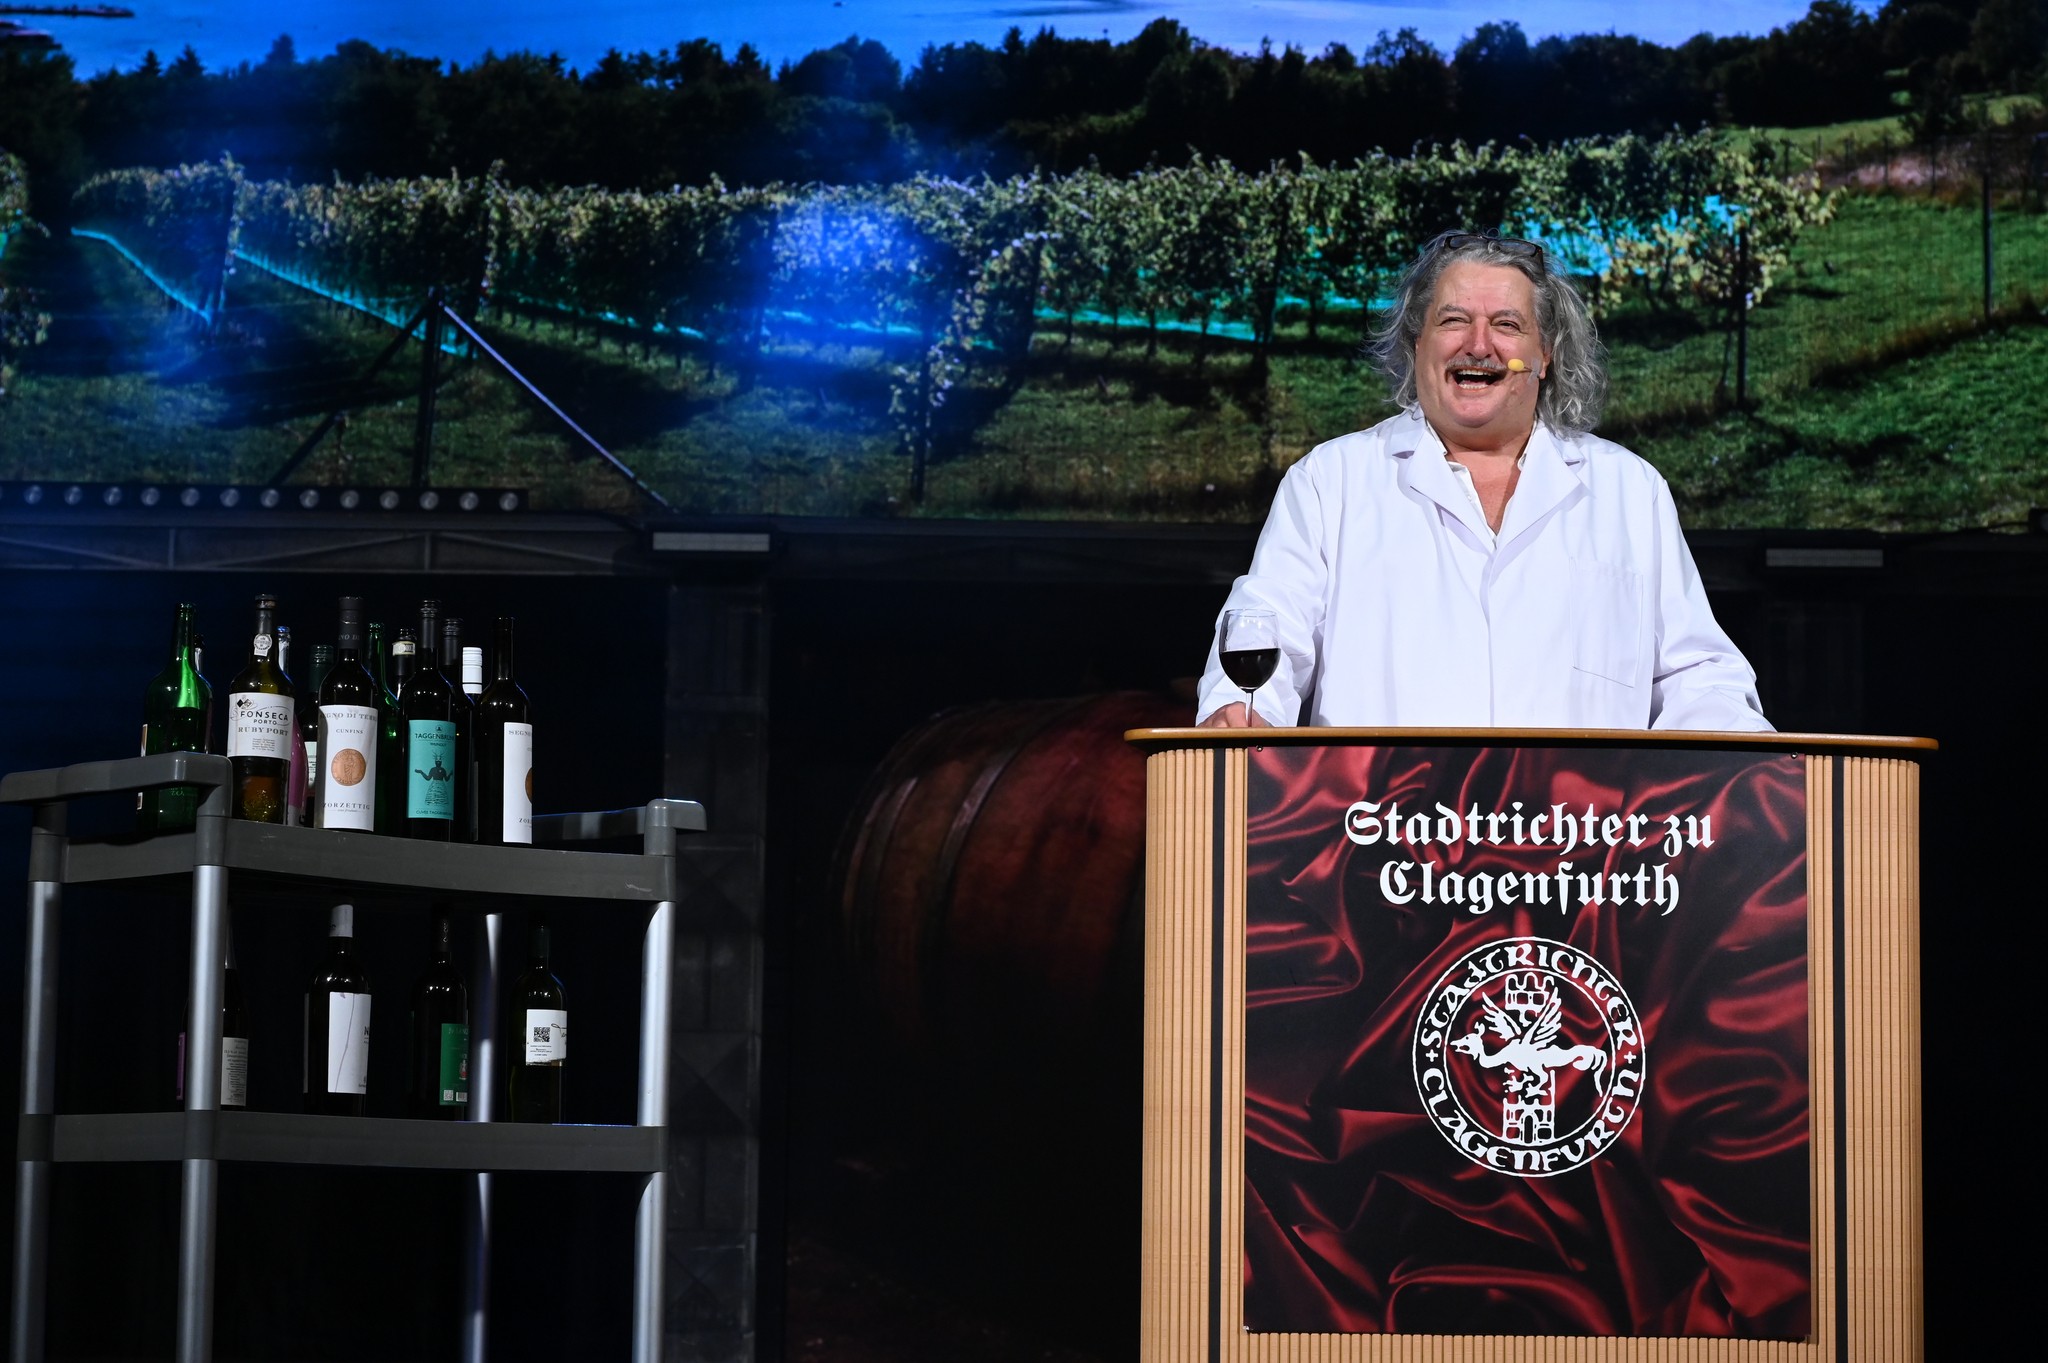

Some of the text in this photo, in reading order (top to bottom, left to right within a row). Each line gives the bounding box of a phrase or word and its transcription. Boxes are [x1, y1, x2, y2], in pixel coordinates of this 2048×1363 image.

[240, 710, 289, 722] FONSECA
[253, 718, 278, 726] PORTO
[238, 726, 289, 737] RUBY PORT
[1344, 800, 1715, 858] Stadtrichter zu
[1379, 860, 1681, 917] Clagenfurth
